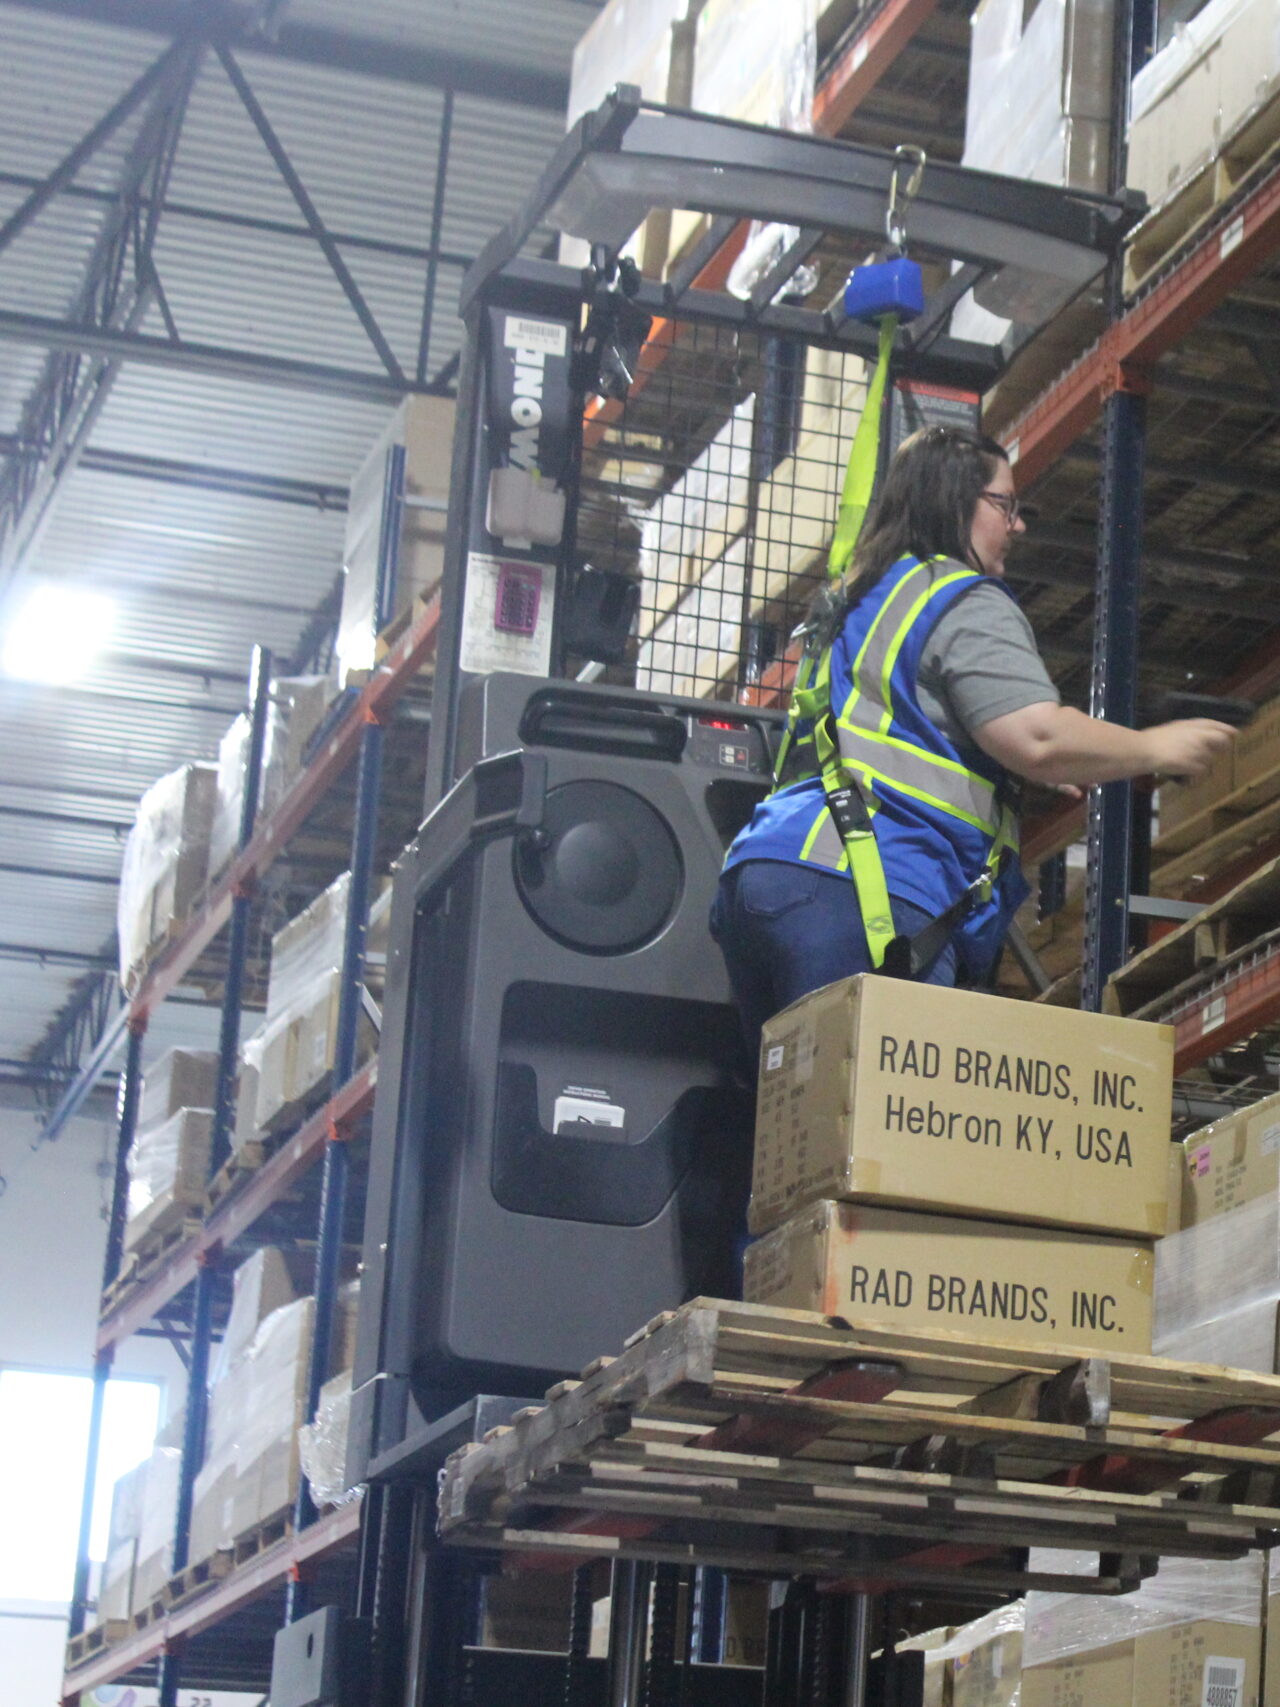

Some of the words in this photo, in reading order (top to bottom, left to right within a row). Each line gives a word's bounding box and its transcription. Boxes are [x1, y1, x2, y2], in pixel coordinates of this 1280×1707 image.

[508, 348, 546, 471] MOND
[879, 1035, 940, 1079] RAD
[954, 1047, 1079, 1106] BRANDS,
[1093, 1070, 1143, 1113] INC.
[885, 1094, 1001, 1147] Hebron
[1016, 1114, 1061, 1160] KY,
[1076, 1123, 1133, 1168] USA
[851, 1265, 912, 1308] RAD
[927, 1274, 1056, 1329] BRANDS,
[1071, 1291, 1124, 1332] INC.
